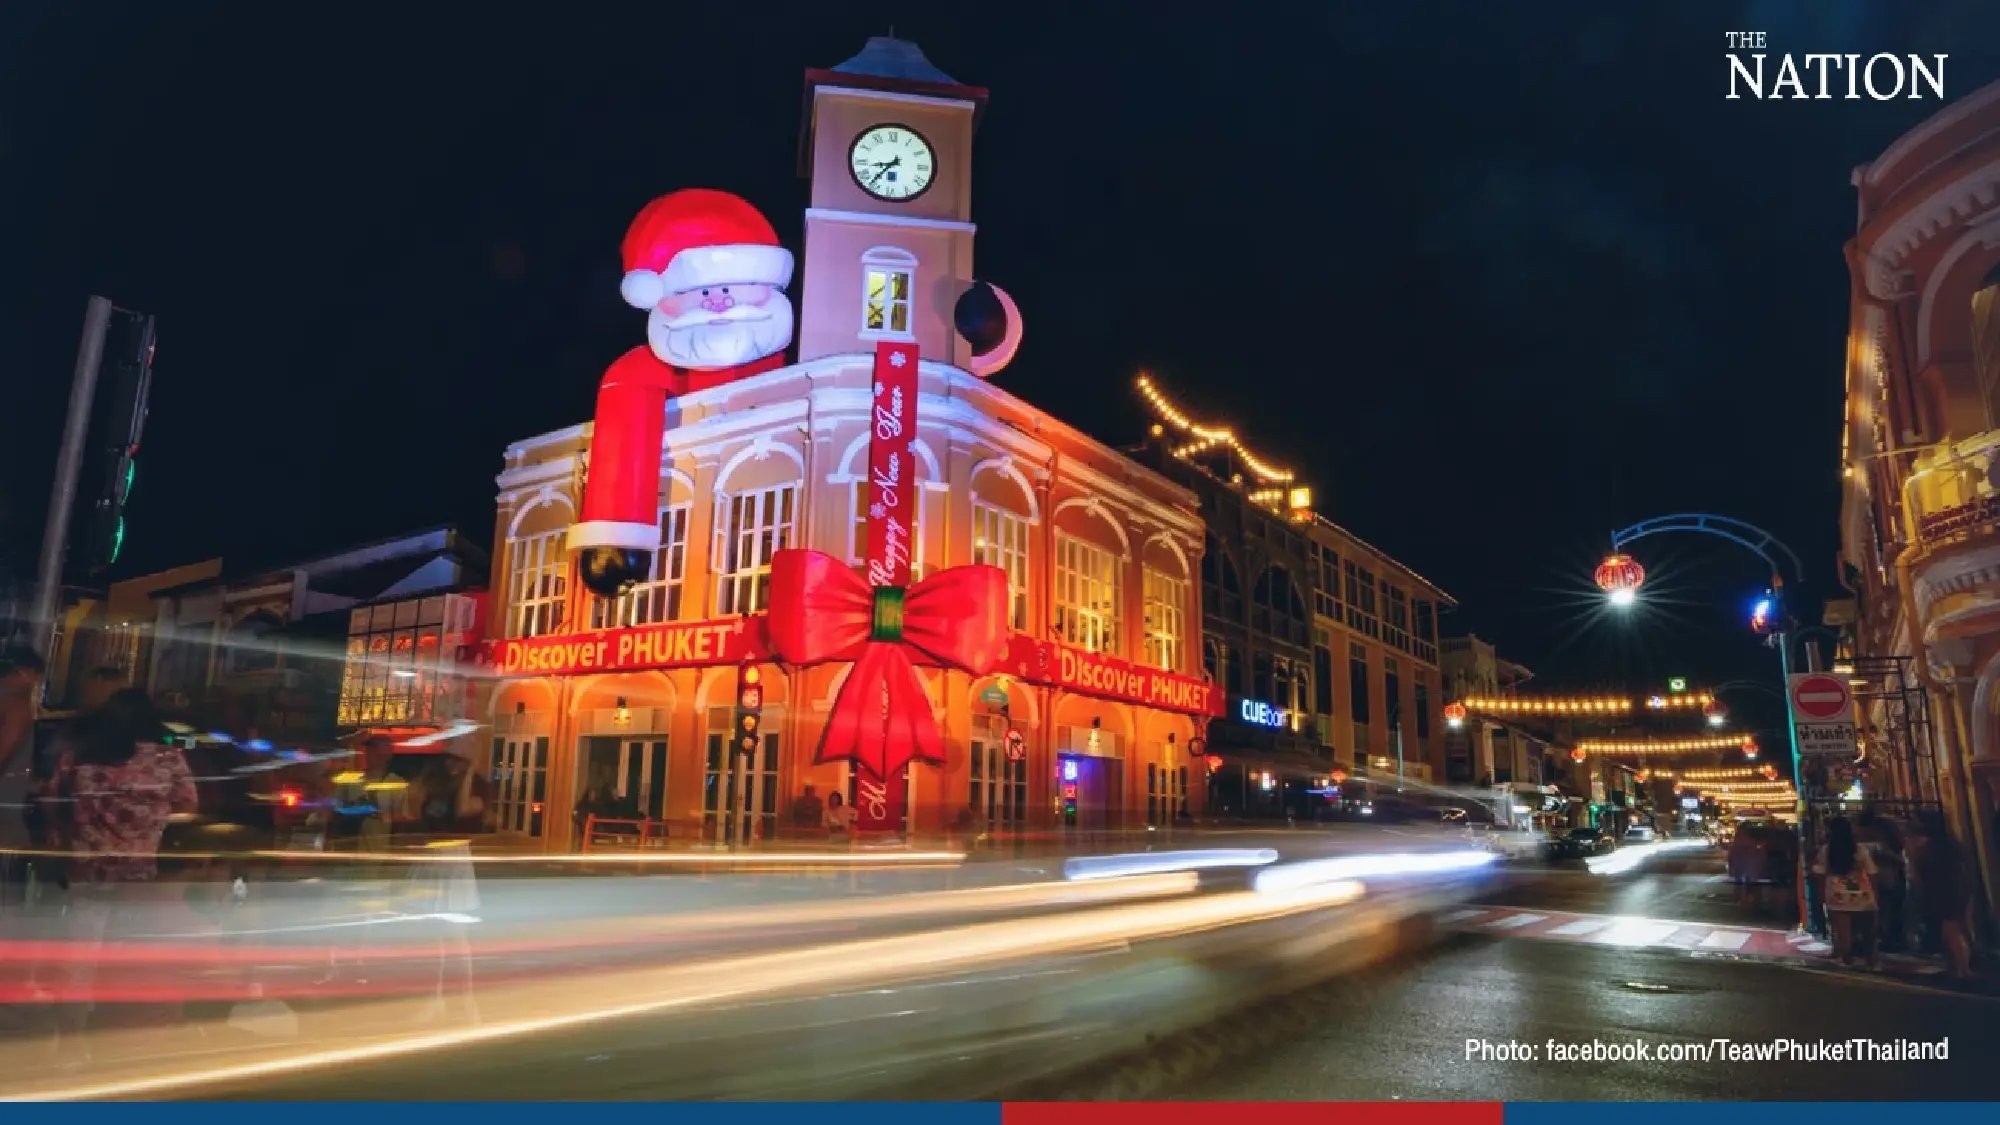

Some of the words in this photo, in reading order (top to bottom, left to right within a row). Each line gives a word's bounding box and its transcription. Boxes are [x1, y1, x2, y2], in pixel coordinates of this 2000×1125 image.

[876, 385, 903, 440] Year
[873, 451, 901, 507] New
[868, 516, 908, 587] Happy
[505, 641, 608, 673] Discover
[618, 625, 733, 666] PHUKET
[1061, 649, 1146, 698] Discover
[1151, 673, 1210, 713] PHUKET
